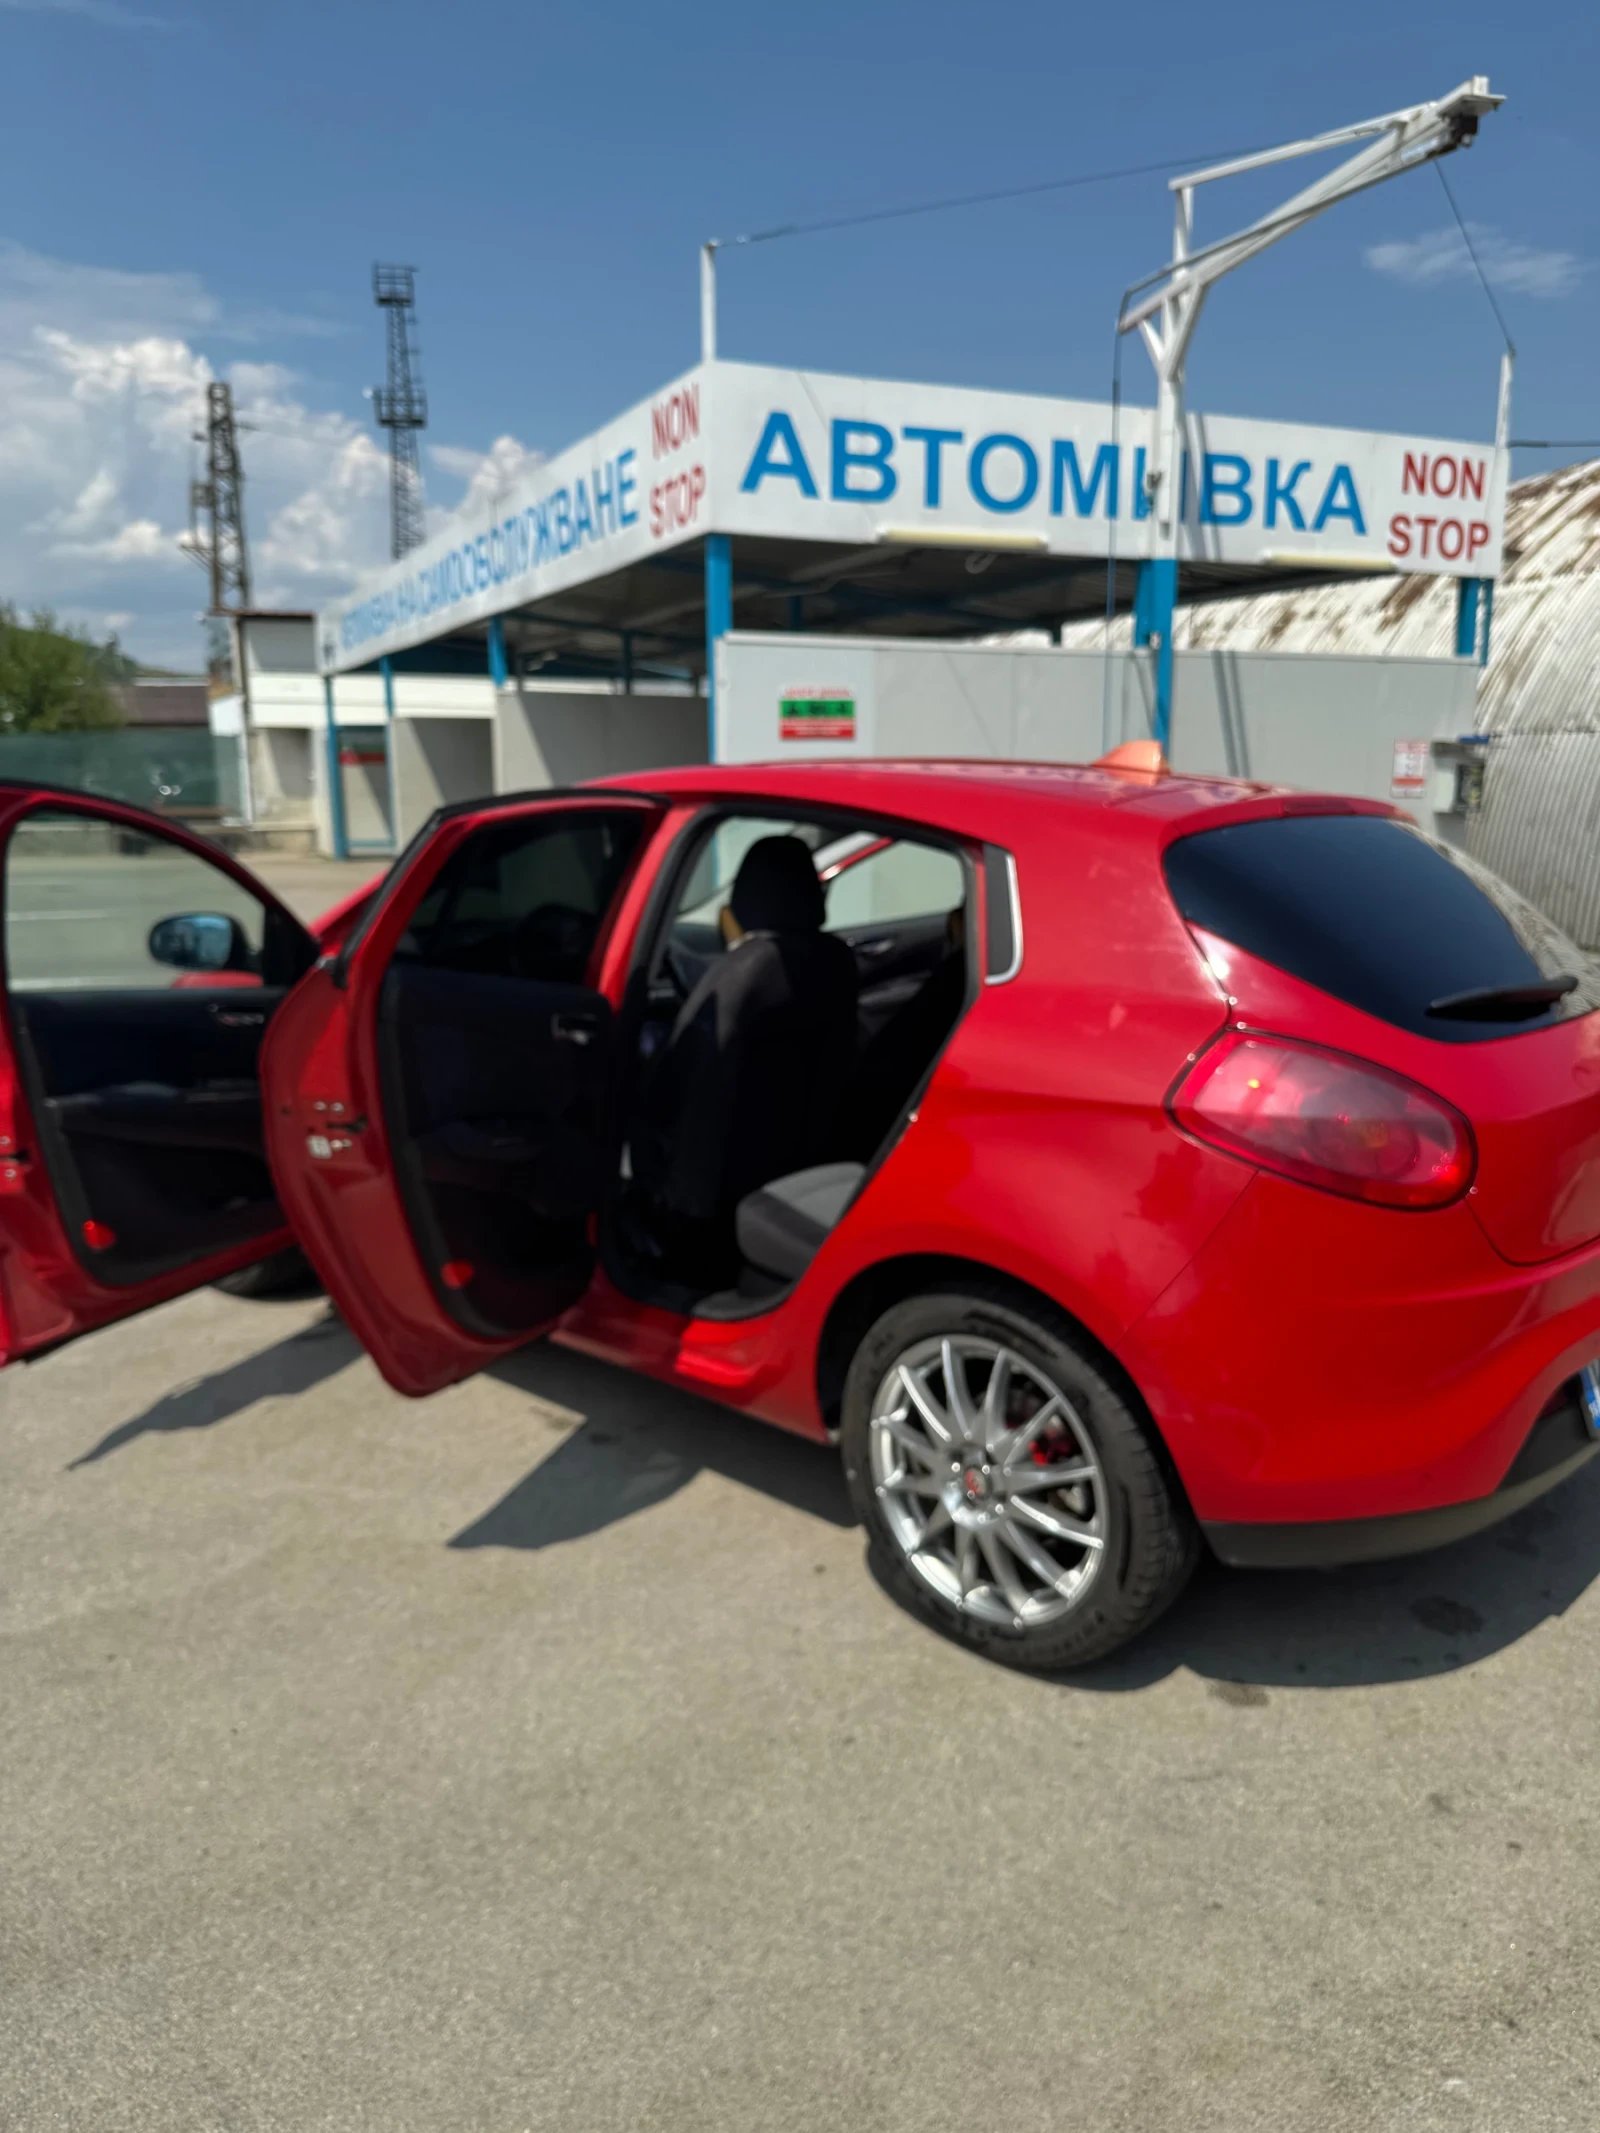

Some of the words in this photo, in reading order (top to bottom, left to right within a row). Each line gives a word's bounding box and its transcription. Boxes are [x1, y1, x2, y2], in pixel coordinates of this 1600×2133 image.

[652, 382, 699, 461] NON
[650, 465, 706, 538] STOP
[1402, 451, 1485, 501] NON
[1388, 513, 1490, 561] STOP
